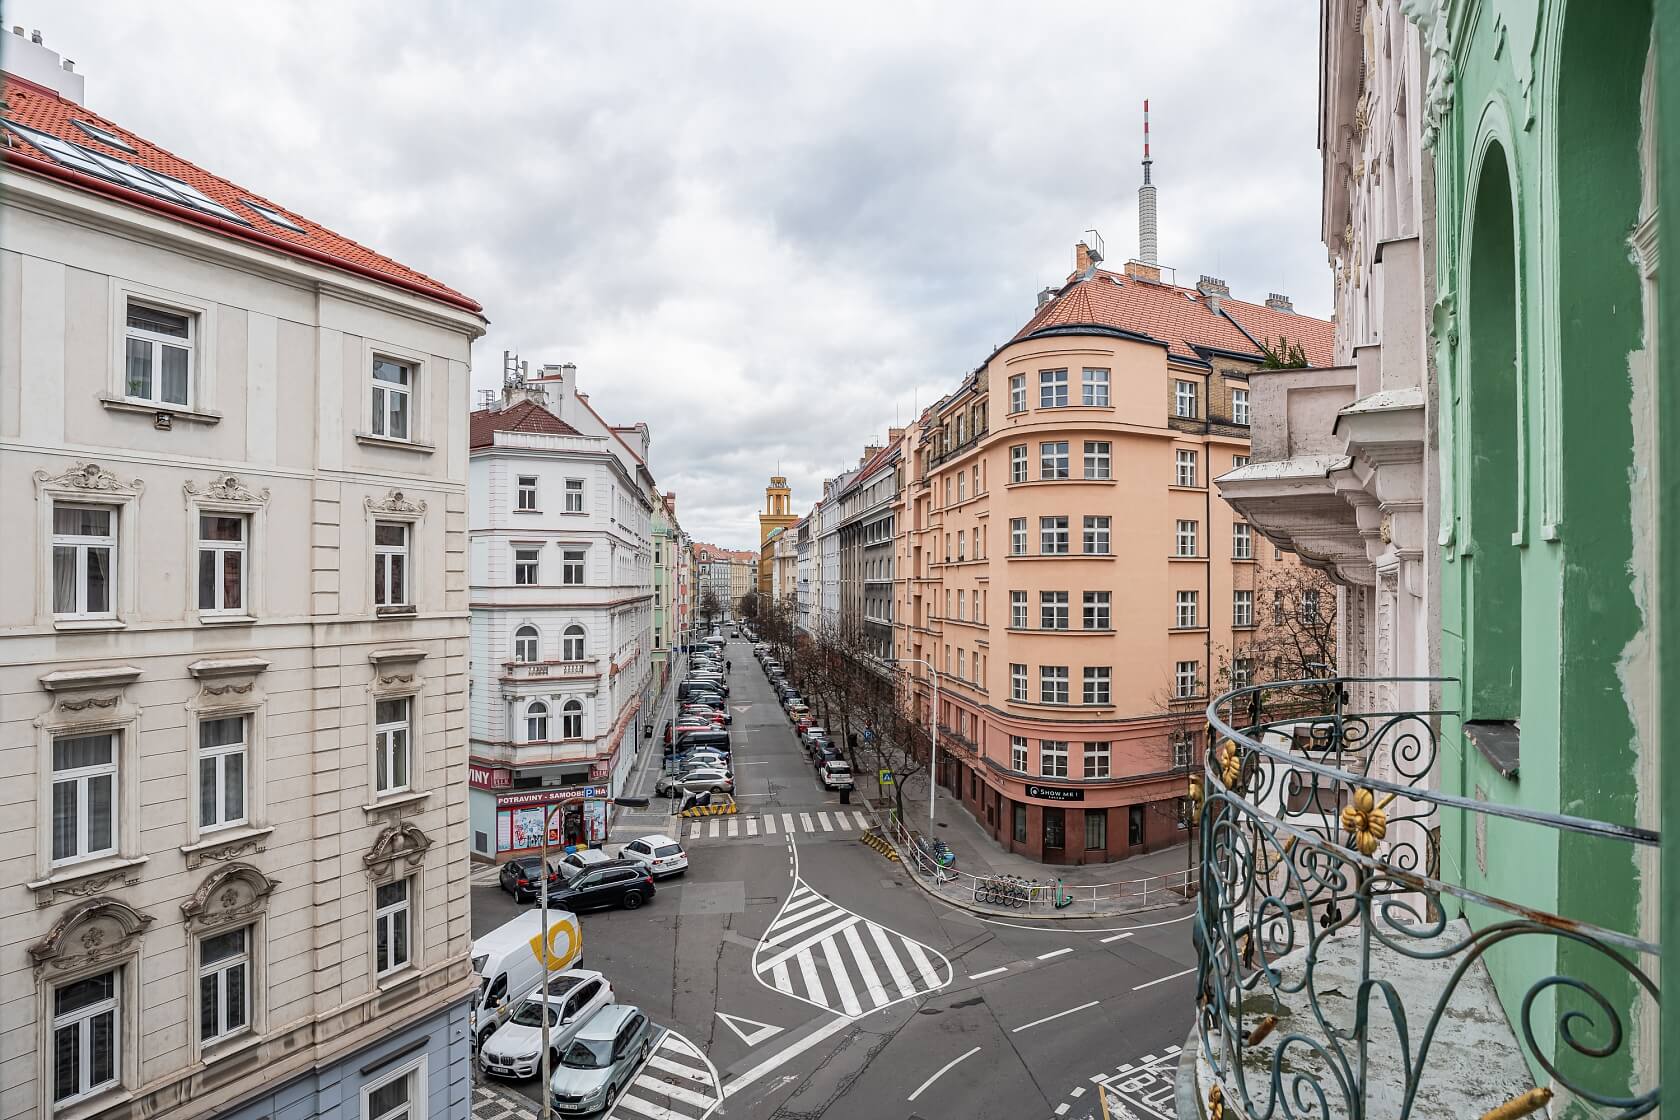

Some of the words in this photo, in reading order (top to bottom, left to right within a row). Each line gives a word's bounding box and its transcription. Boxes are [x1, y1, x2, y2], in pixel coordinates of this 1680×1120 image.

[498, 794, 543, 805] POTRAVINY
[549, 788, 606, 800] SAMOOBHA
[586, 789, 593, 798] P
[1040, 788, 1061, 797] SHOW
